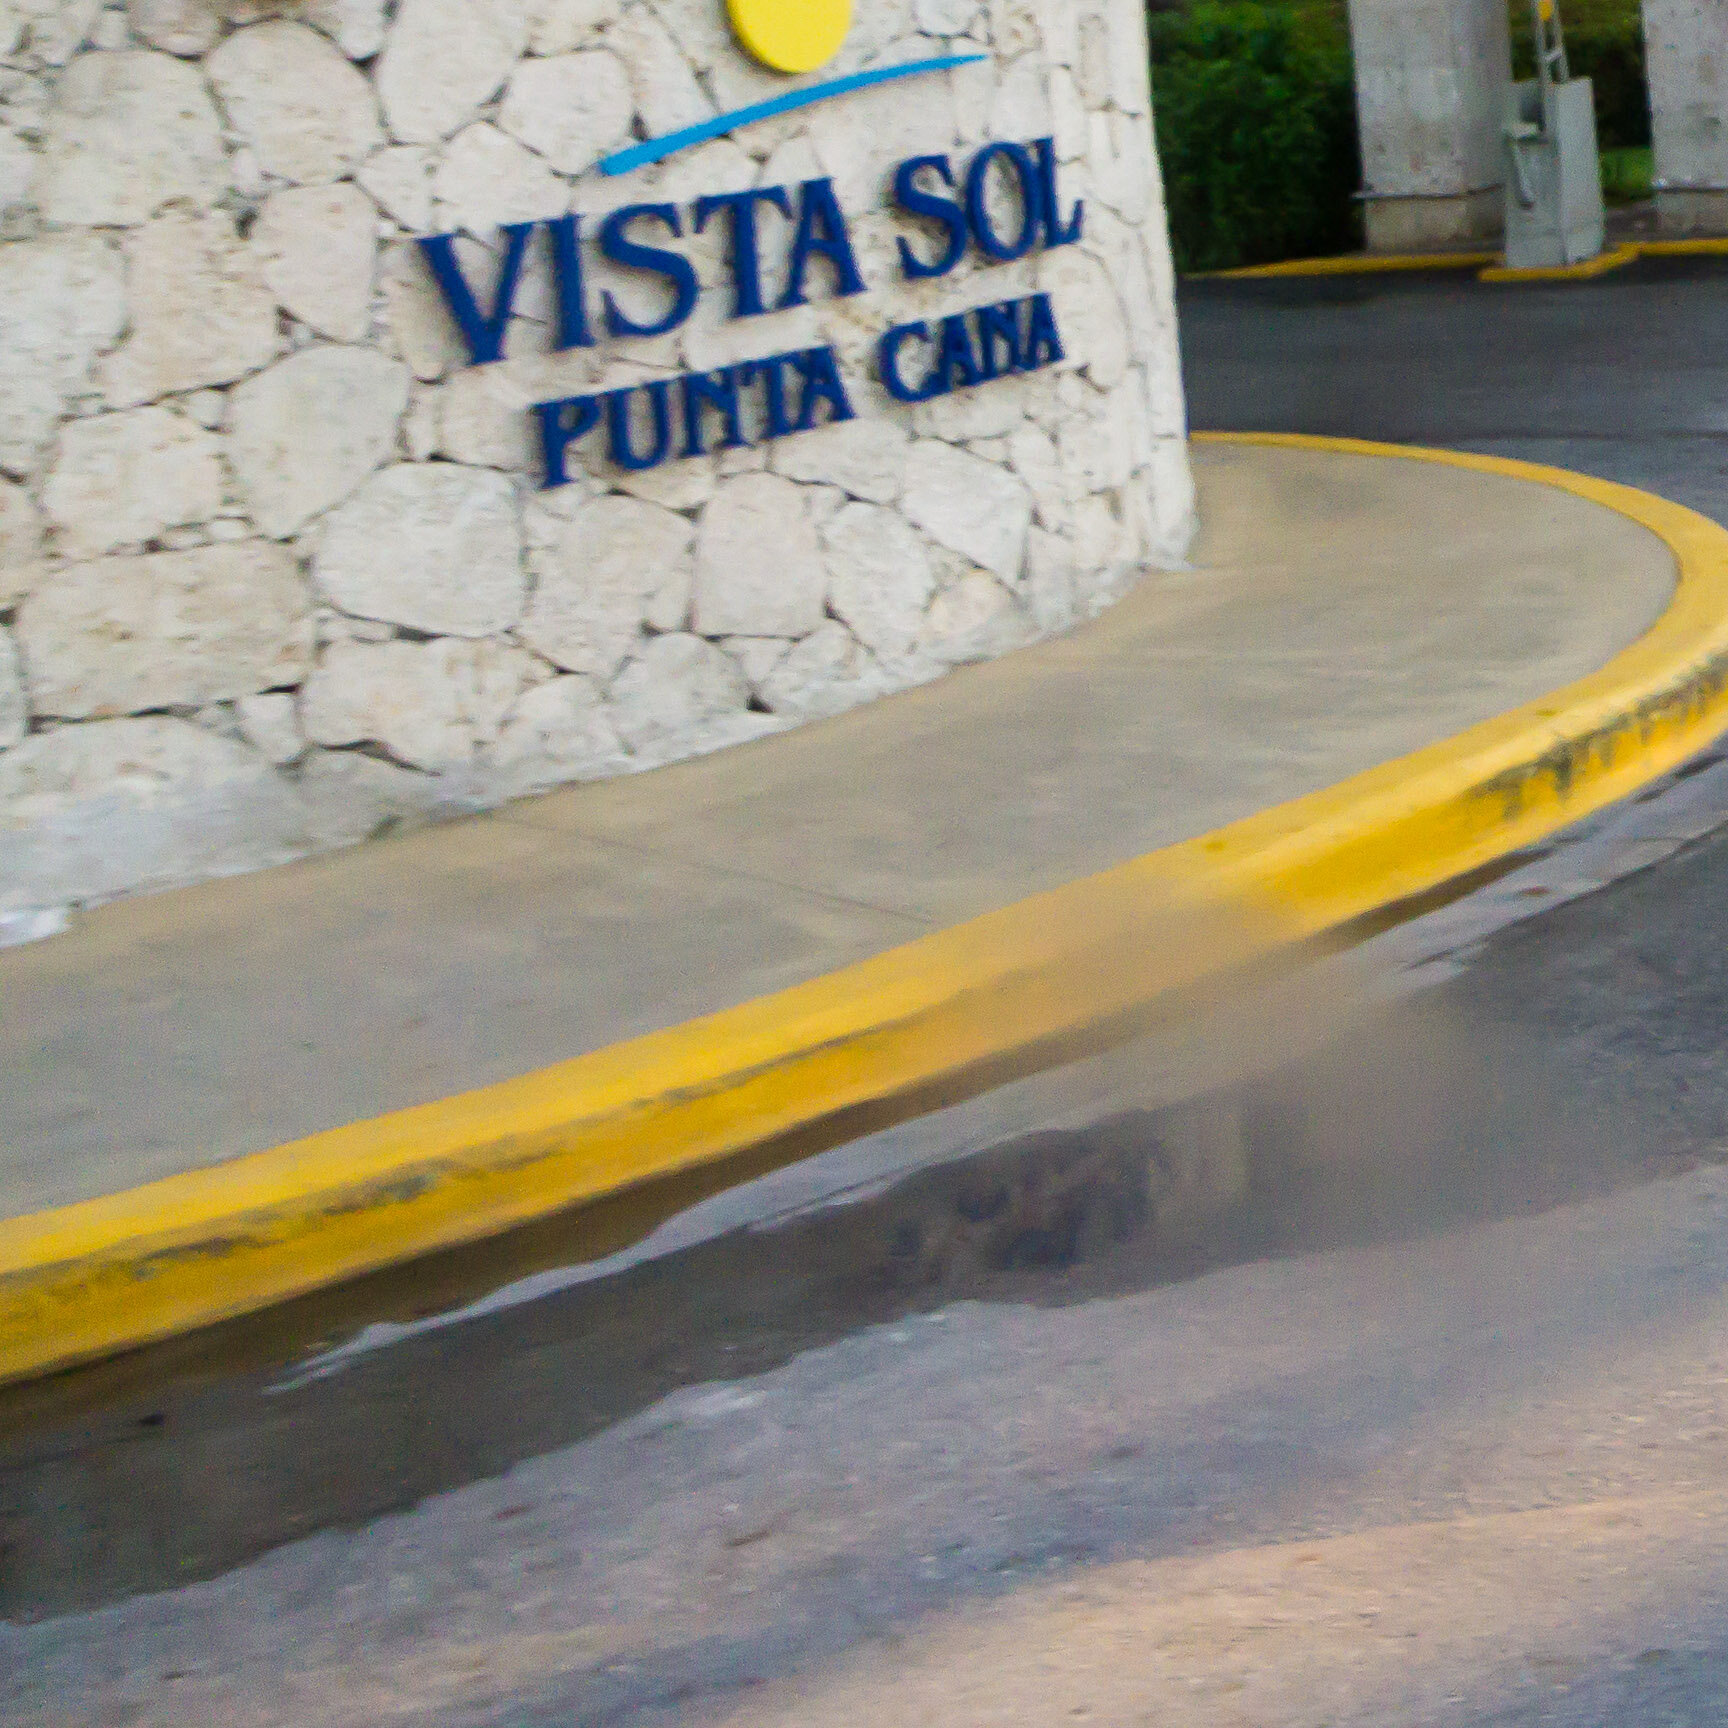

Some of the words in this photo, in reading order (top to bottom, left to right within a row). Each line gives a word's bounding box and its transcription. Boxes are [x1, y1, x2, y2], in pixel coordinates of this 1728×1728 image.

[413, 176, 868, 368] VISTA
[888, 135, 1085, 281] SOL
[530, 345, 858, 491] PUNTA
[876, 291, 1067, 404] CANA
